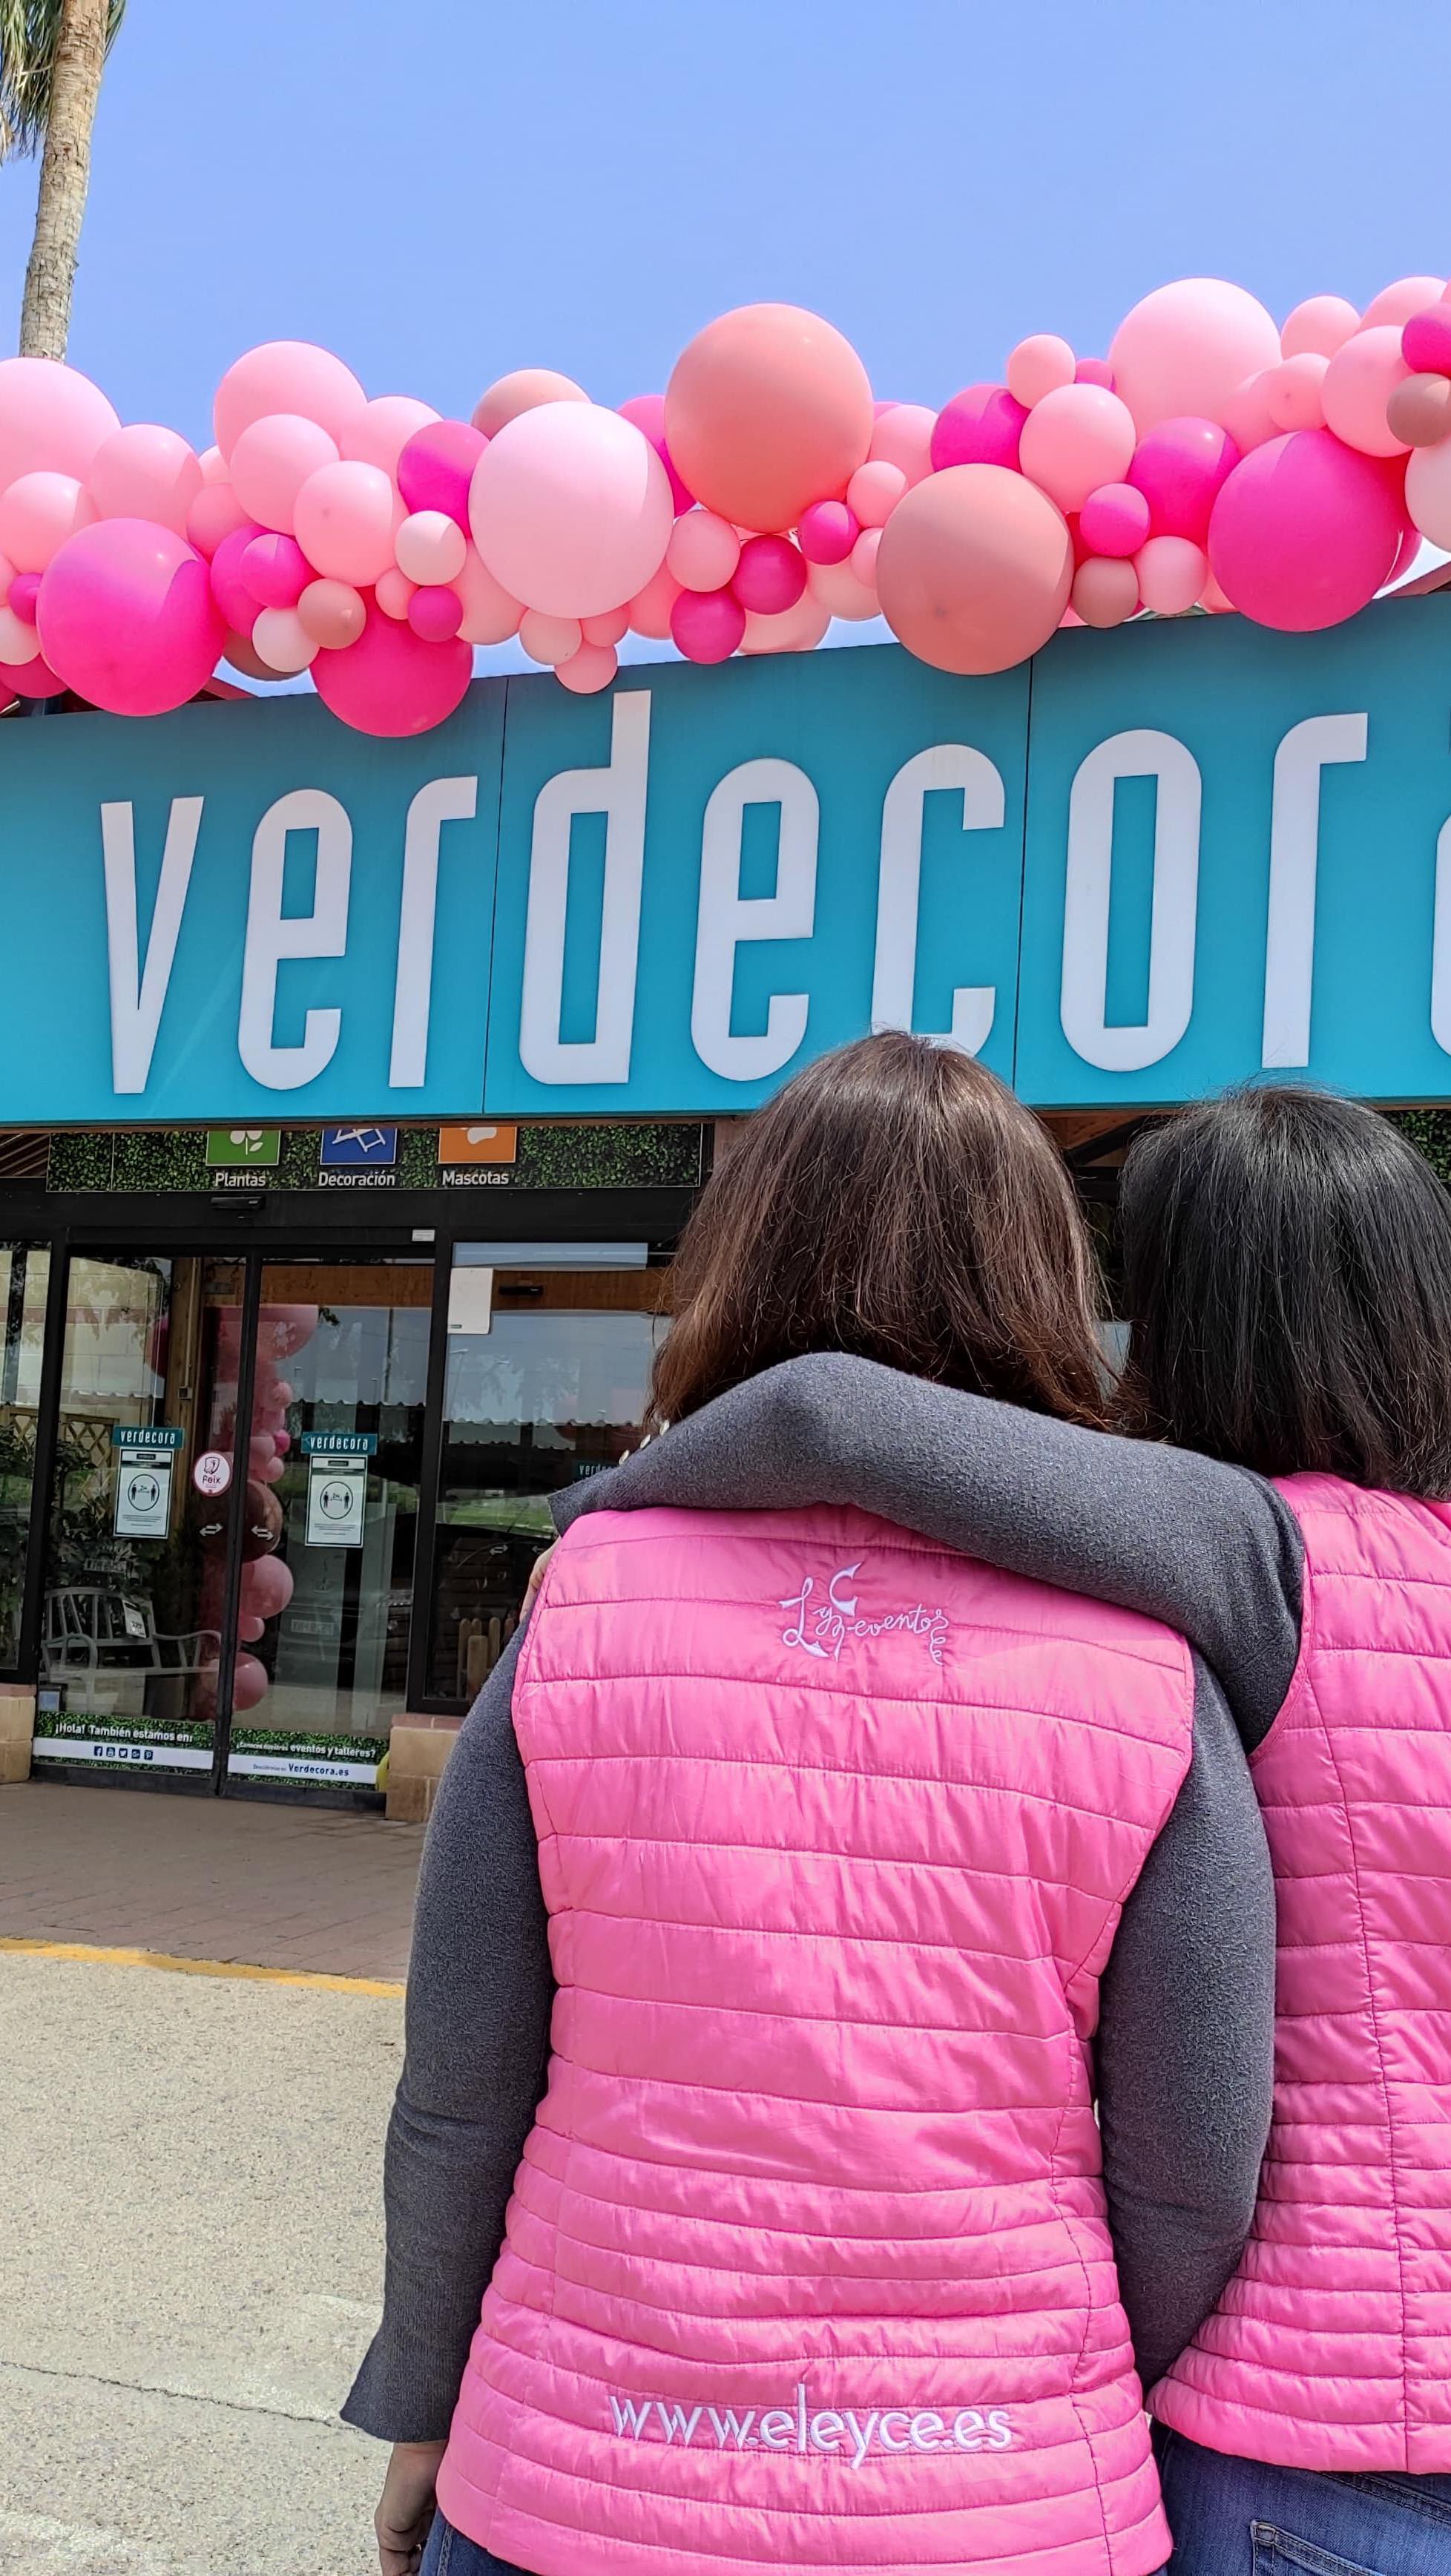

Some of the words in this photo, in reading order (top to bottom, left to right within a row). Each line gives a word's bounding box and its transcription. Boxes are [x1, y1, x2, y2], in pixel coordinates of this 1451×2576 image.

[214, 1172, 266, 1186] Plantas
[318, 1170, 395, 1186] Decoración
[442, 1170, 510, 1186] Mascotas
[120, 1429, 176, 1445] verdecora
[310, 1435, 369, 1450] verdecora
[56, 1722, 85, 1735] ¡Hola!
[89, 1724, 131, 1738] También
[133, 1729, 175, 1741] estamos
[290, 1744, 326, 1755] eventos
[327, 1747, 334, 1758] y
[335, 1746, 375, 1758] talleres?
[289, 1763, 349, 1777] Verdecora.es
[609, 2383, 1013, 2470] www.eleyce.es
